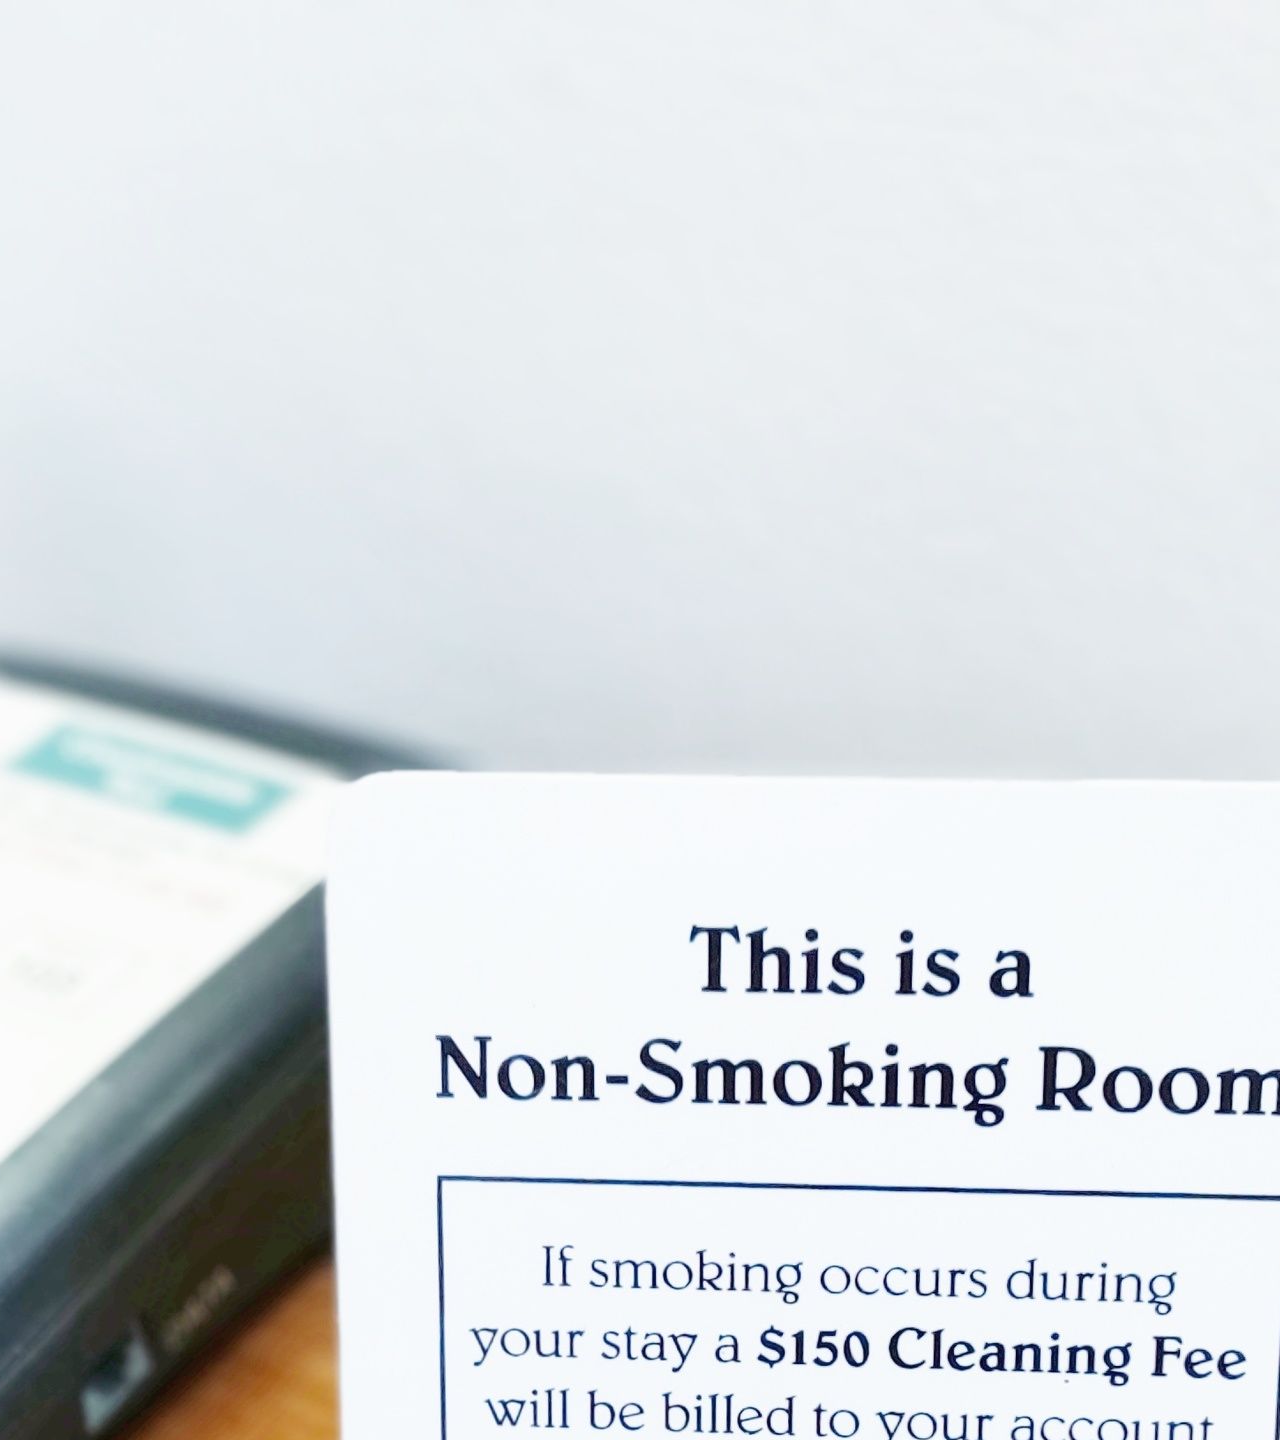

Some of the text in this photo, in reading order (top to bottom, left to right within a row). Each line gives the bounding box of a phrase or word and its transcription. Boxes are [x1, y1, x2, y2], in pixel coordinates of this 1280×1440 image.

[690, 926, 1034, 998] This is a
[436, 1036, 1008, 1127] Non-Smoking
[544, 1246, 1176, 1315] If smoking occurs during
[471, 1326, 1246, 1386] your stay a $150 Cleaning Fee
[486, 1390, 568, 1428] will
[588, 1391, 644, 1430] be
[663, 1393, 794, 1435] billed
[814, 1405, 859, 1438] to
